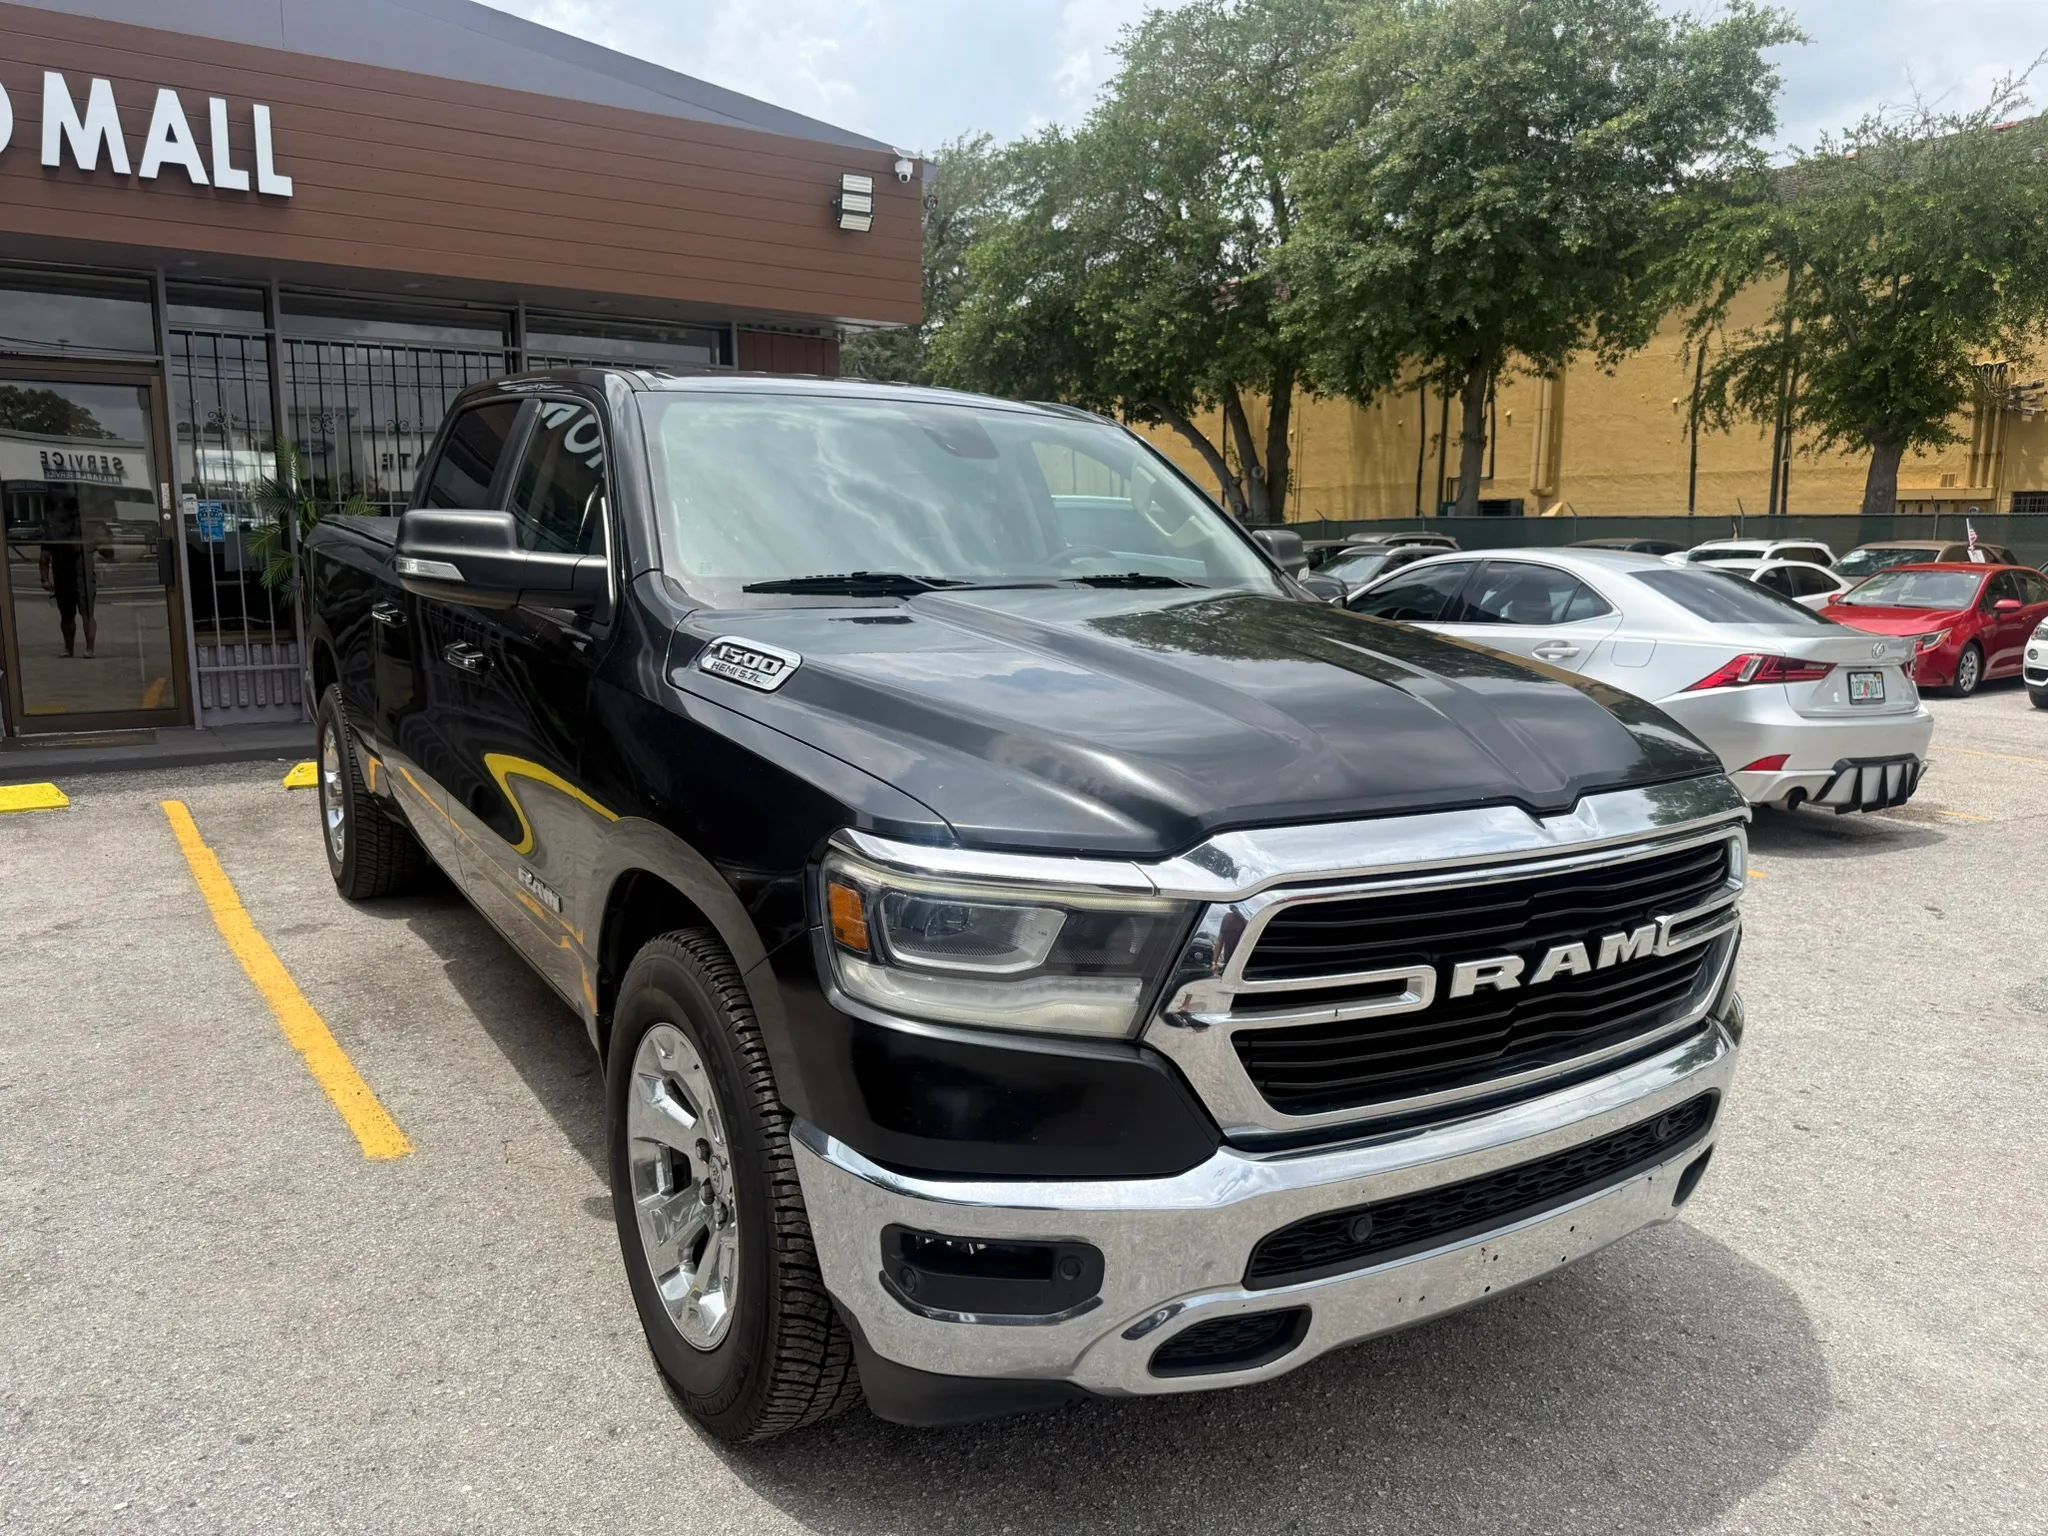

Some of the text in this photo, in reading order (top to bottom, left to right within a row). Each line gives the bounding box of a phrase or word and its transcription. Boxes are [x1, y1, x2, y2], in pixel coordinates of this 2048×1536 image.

[41, 70, 293, 197] MALL
[710, 660, 762, 683] HEMI 5.7L
[718, 644, 784, 676] 1500
[518, 867, 561, 913] RAM
[1449, 924, 1657, 999] RAM
